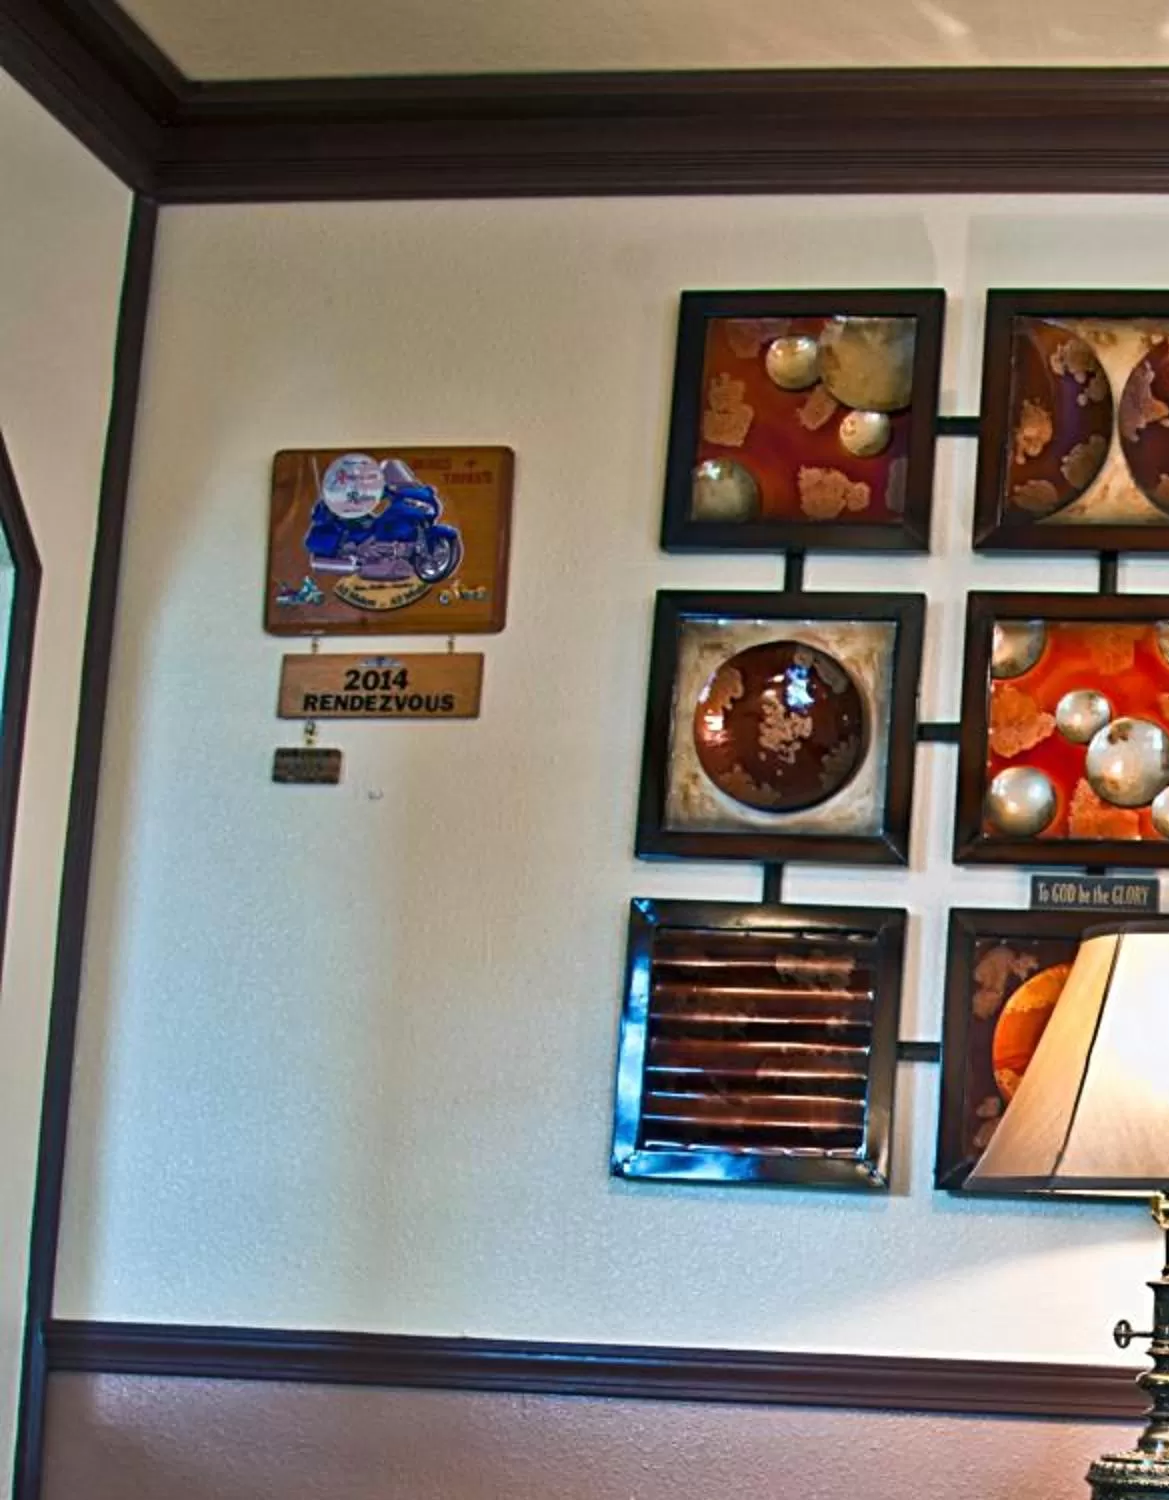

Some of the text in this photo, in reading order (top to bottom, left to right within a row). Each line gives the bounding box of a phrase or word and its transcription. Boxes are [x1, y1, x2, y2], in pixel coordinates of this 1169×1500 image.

[344, 670, 408, 691] 2014
[303, 693, 455, 713] RENDEZVOUS
[1051, 883, 1077, 903] GOD
[1079, 884, 1090, 903] be
[1093, 885, 1109, 904] the
